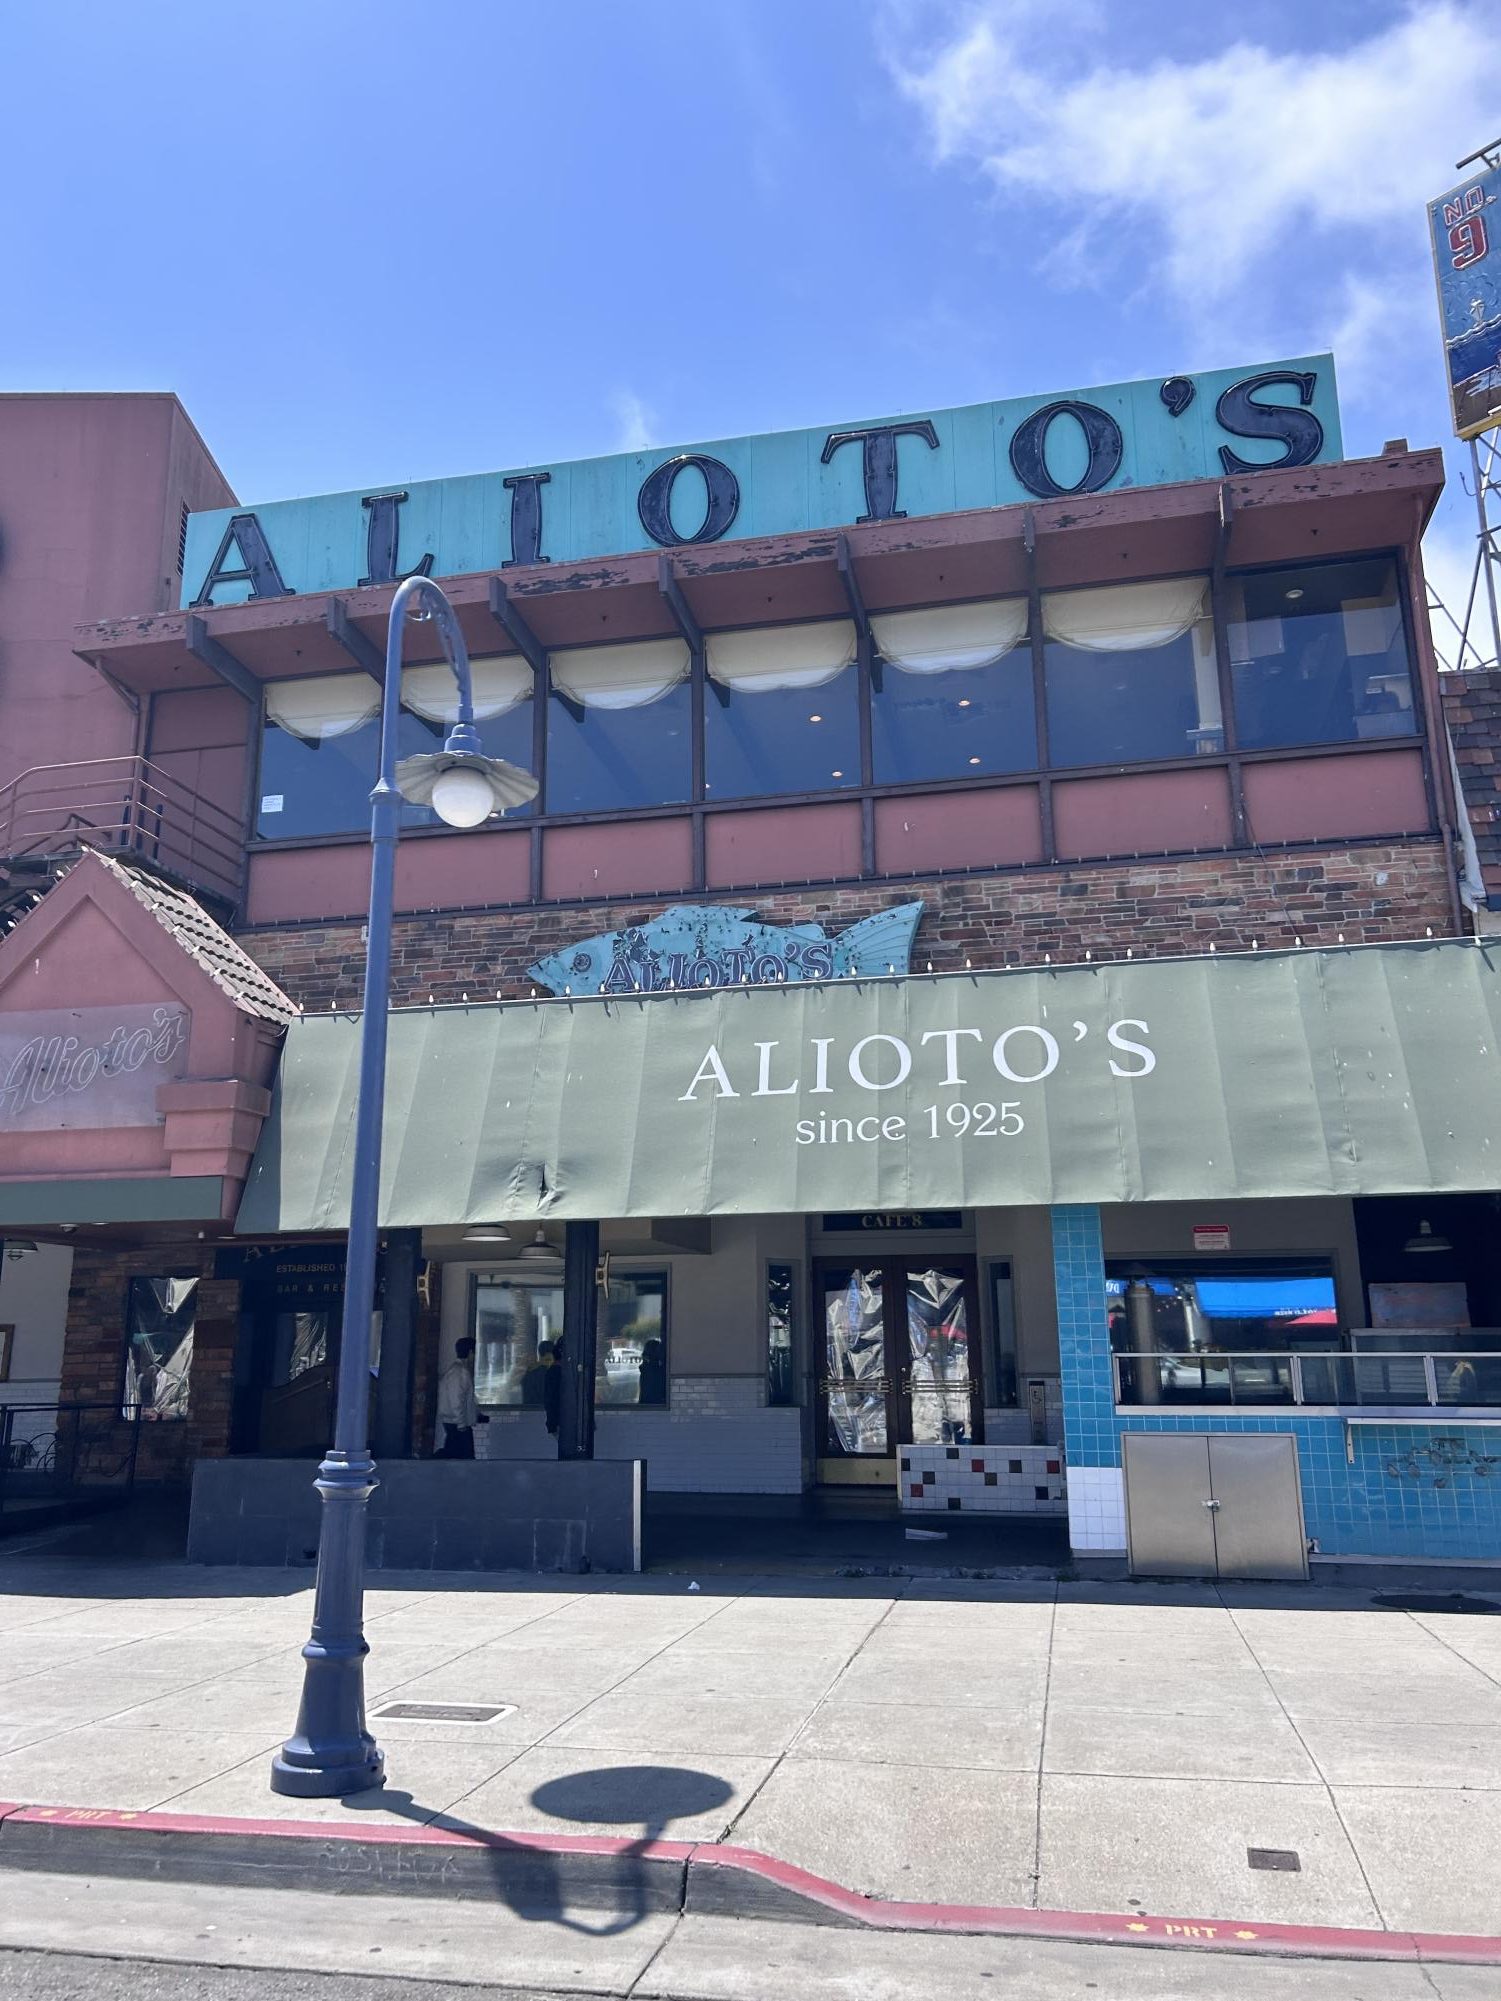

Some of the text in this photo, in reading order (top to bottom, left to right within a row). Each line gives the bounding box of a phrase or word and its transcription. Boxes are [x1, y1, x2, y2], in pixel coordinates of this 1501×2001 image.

[1443, 185, 1496, 226] NO.
[1448, 216, 1488, 270] 9
[188, 371, 1324, 609] ALIOTO'S
[1, 1009, 186, 1116] Alioto's
[678, 1019, 1157, 1101] ALIOTO'S
[795, 1102, 1025, 1145] since 1925
[276, 1264, 335, 1273] ESTABLISHED
[277, 1284, 299, 1293] BAR
[1165, 1924, 1217, 1938] PRT
